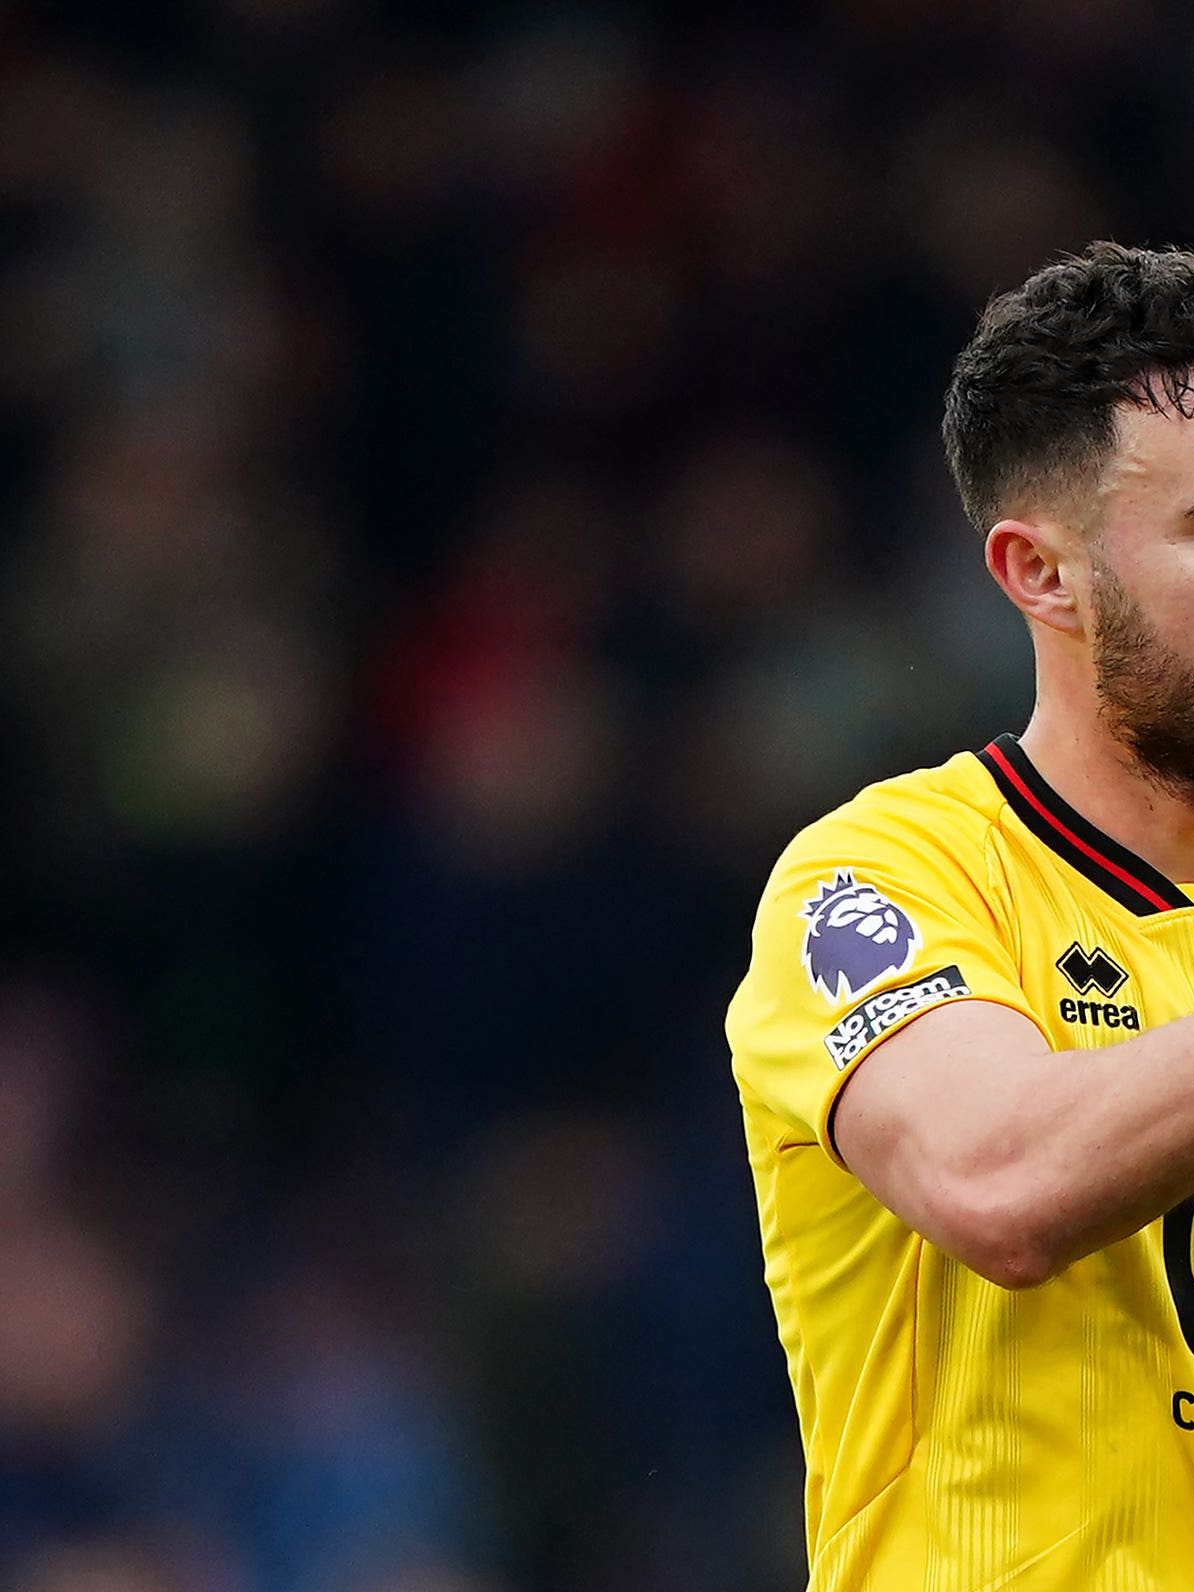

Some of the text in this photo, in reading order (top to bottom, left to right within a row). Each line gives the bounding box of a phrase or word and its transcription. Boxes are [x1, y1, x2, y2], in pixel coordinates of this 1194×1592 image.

[824, 977, 951, 1055] No room
[870, 986, 972, 1035] racm
[1059, 998, 1140, 1031] errea
